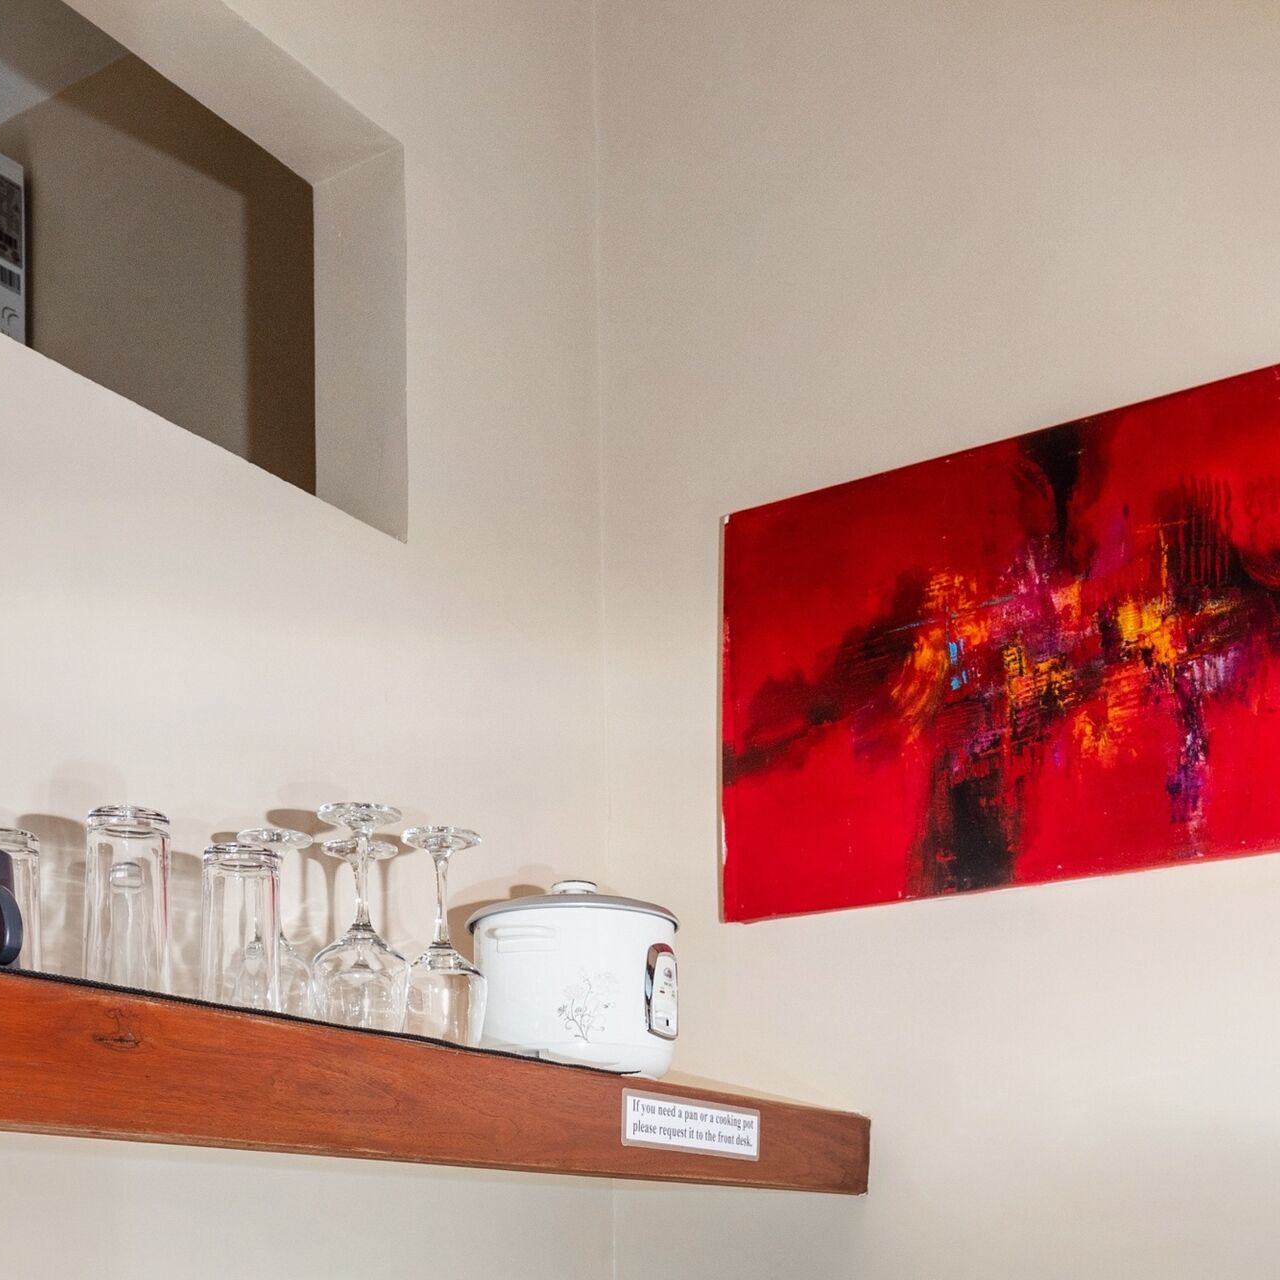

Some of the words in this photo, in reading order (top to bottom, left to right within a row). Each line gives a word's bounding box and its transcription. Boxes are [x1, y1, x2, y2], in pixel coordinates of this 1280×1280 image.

[632, 1099, 640, 1112] If
[641, 1104, 655, 1116] you
[658, 1106, 676, 1117] need
[678, 1109, 682, 1118] a
[684, 1110, 698, 1123] pan
[700, 1113, 708, 1122] or
[710, 1114, 714, 1123] a
[716, 1115, 741, 1130] cooking
[743, 1119, 754, 1131] pot
[633, 1120, 657, 1135] please
[659, 1126, 687, 1140] request
[689, 1128, 695, 1139] it
[696, 1130, 704, 1141] to
[705, 1130, 715, 1142] the
[718, 1131, 735, 1145] front
[736, 1134, 753, 1147] desk.
